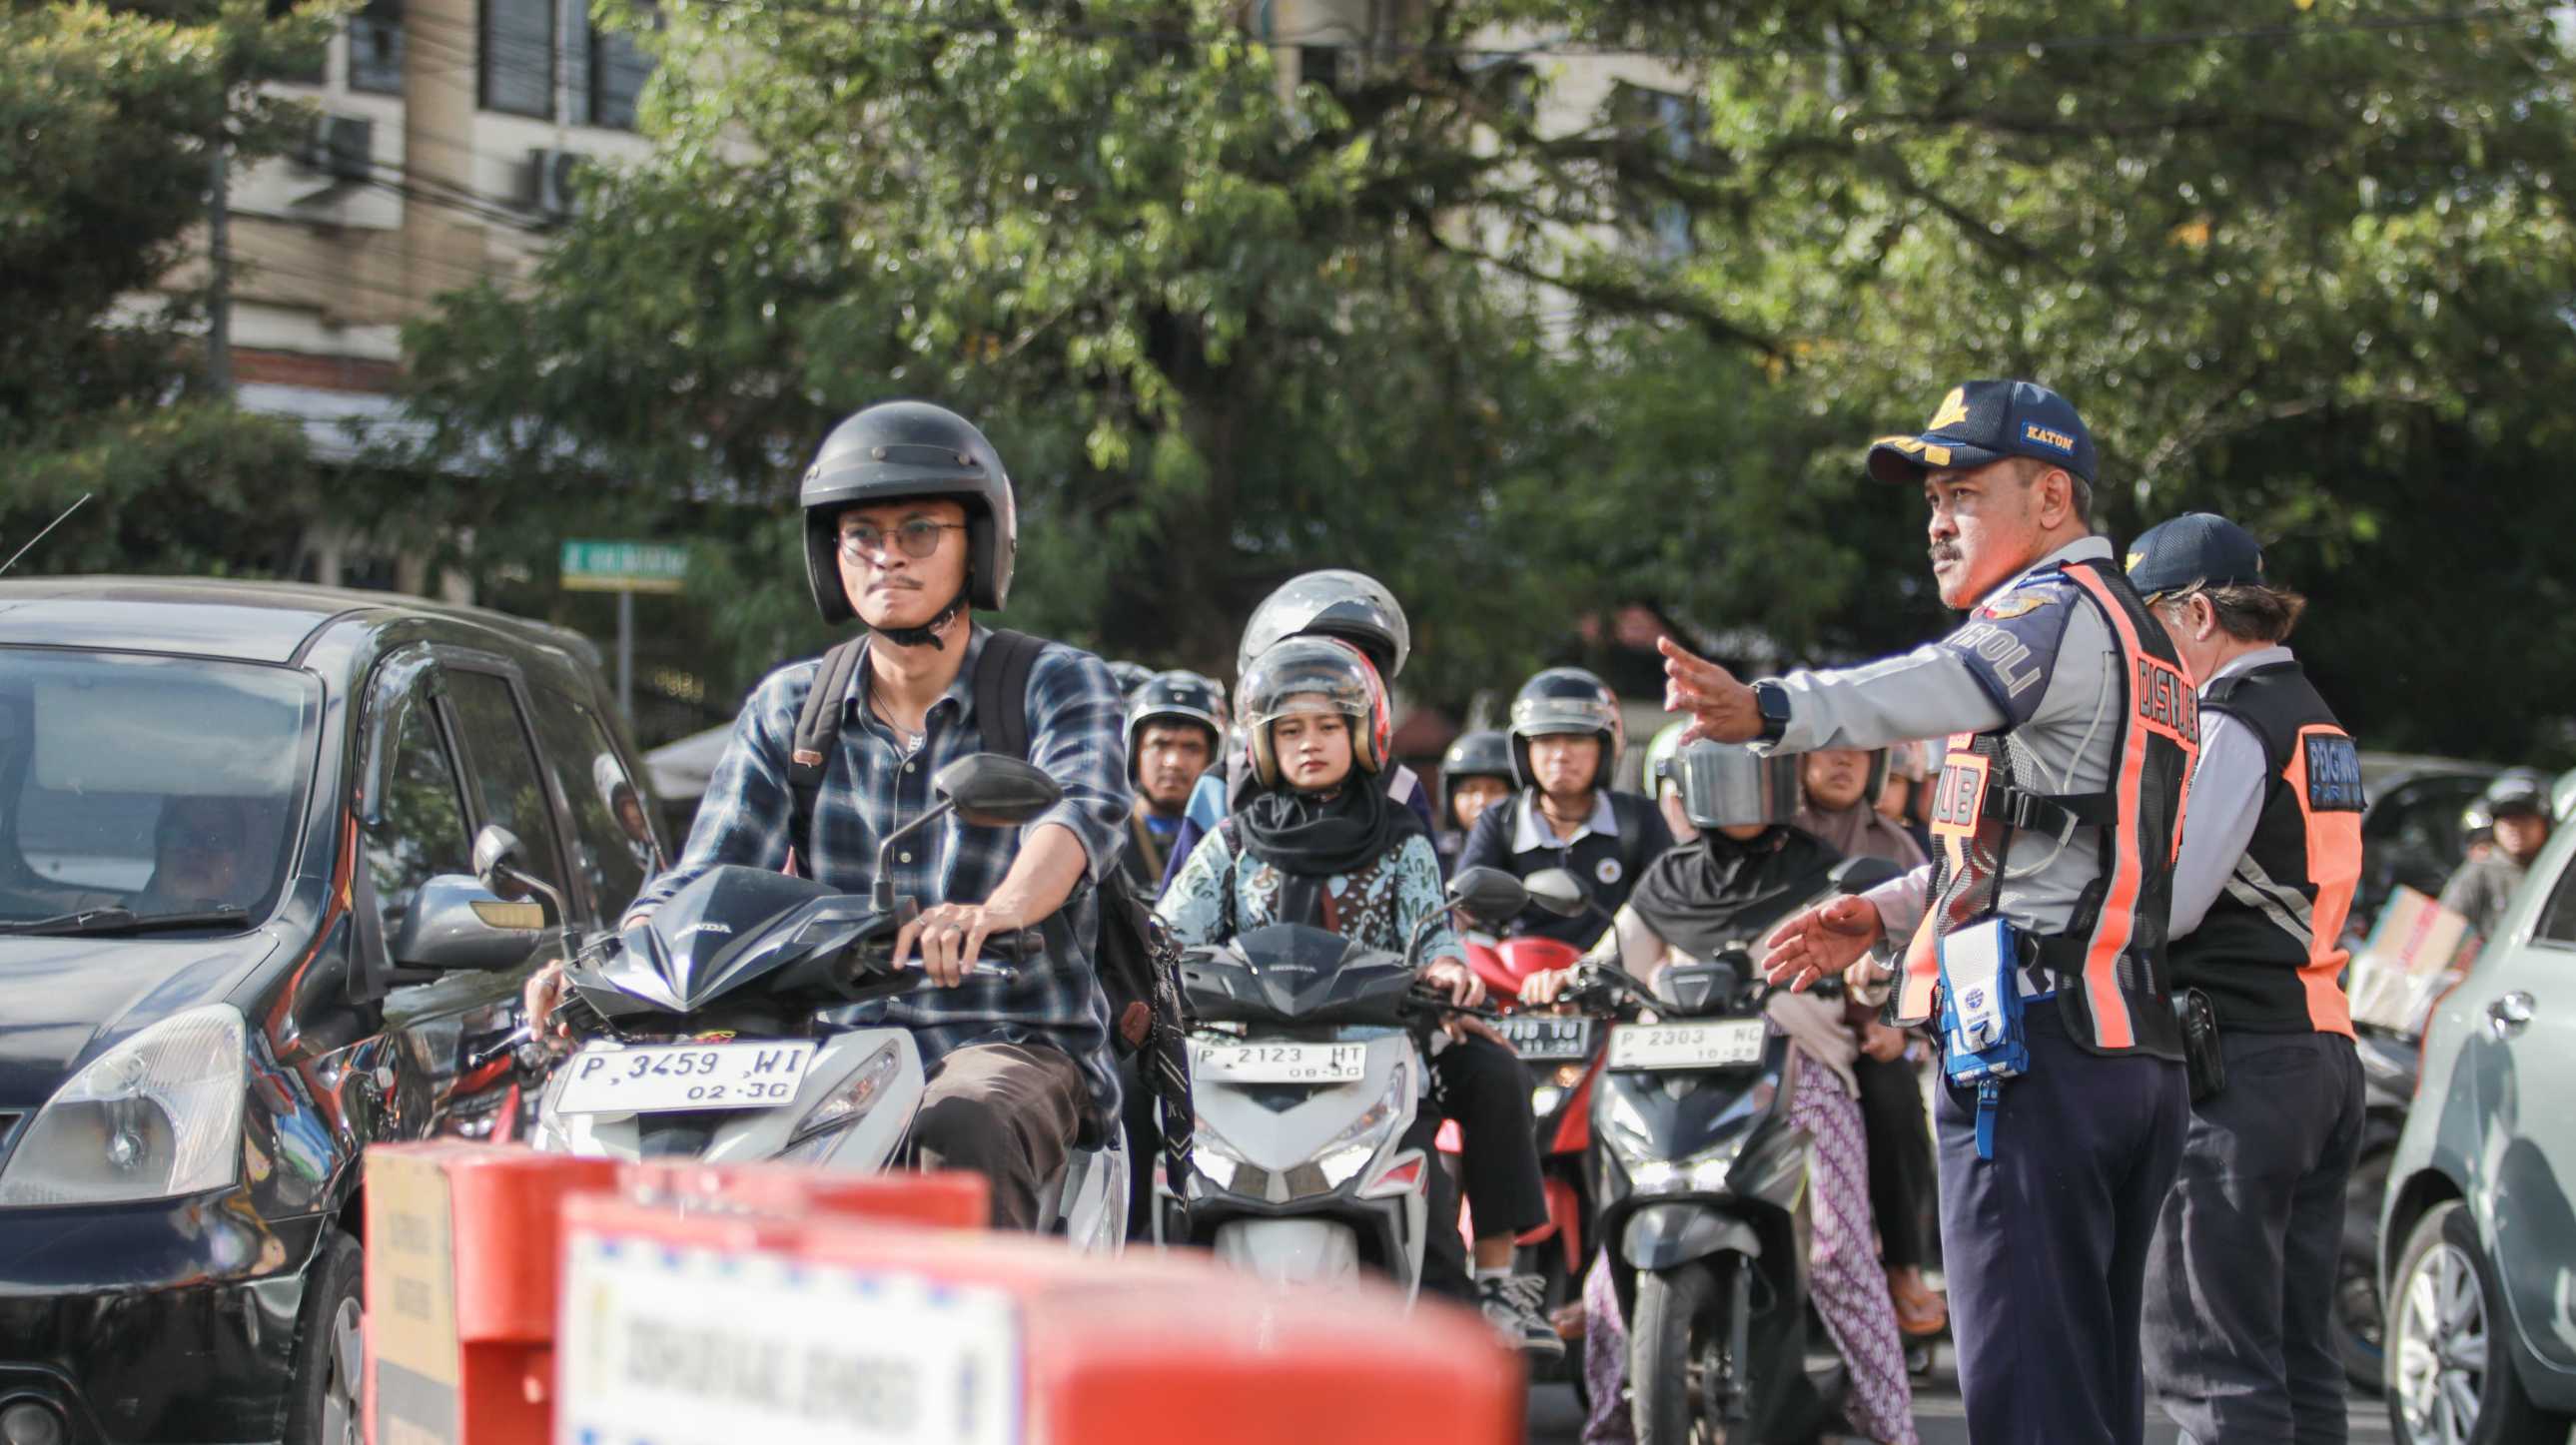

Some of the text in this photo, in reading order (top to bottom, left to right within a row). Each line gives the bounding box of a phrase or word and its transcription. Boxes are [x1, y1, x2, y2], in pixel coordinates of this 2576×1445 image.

[2027, 426, 2074, 450] KATON
[1621, 1032, 1635, 1046] P
[1648, 1030, 1705, 1047] 2303
[579, 1049, 803, 1081] P 3459 WI
[1200, 1048, 1363, 1063] P 2123 HT
